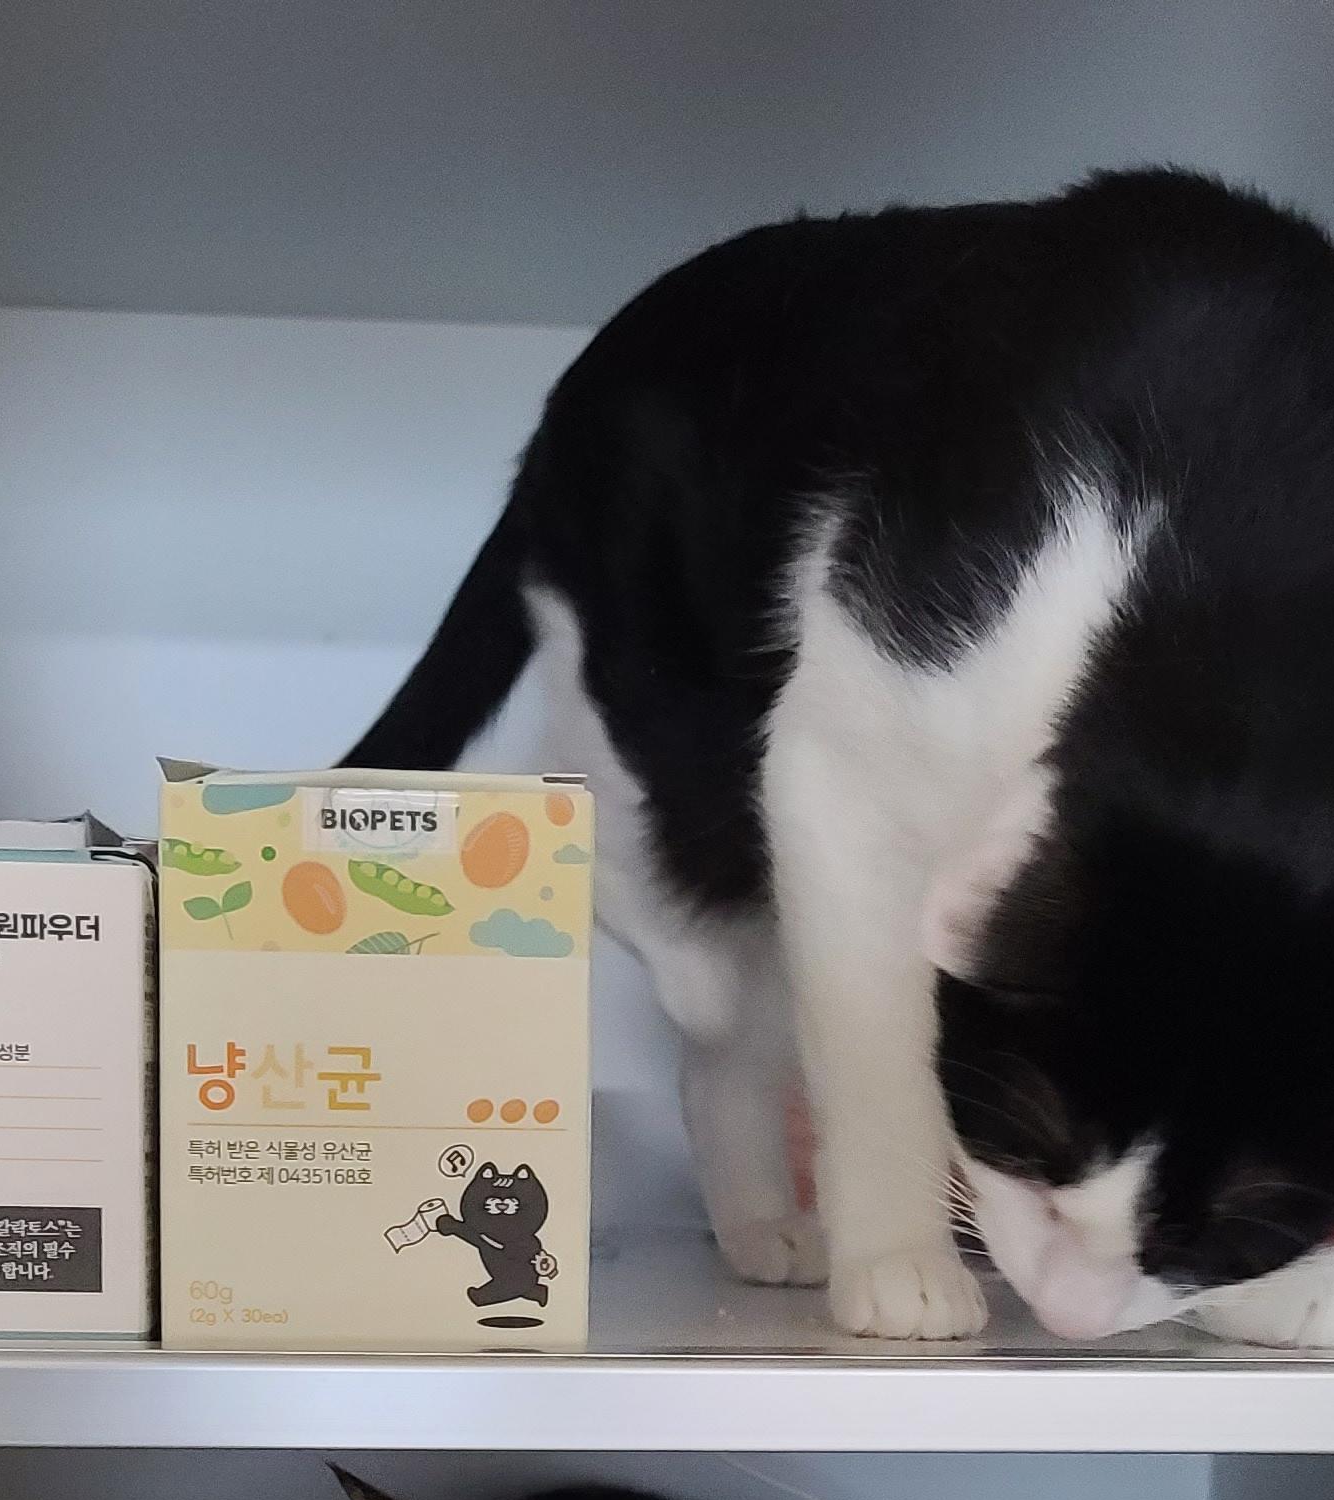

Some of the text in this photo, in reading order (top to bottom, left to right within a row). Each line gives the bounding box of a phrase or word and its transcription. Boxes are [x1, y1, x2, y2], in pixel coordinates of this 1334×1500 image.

[320, 808, 438, 832] BIOPETS
[186, 1041, 381, 1111] 냥산균
[187, 1139, 373, 1162] 특허 받은 식물성 유산균
[187, 1165, 373, 1186] 특허번호 제 0435168호
[42, 1240, 77, 1261] 필수
[189, 1279, 234, 1305] 60g
[189, 1308, 217, 1327] (2g
[242, 1308, 289, 1325] 30ea)
